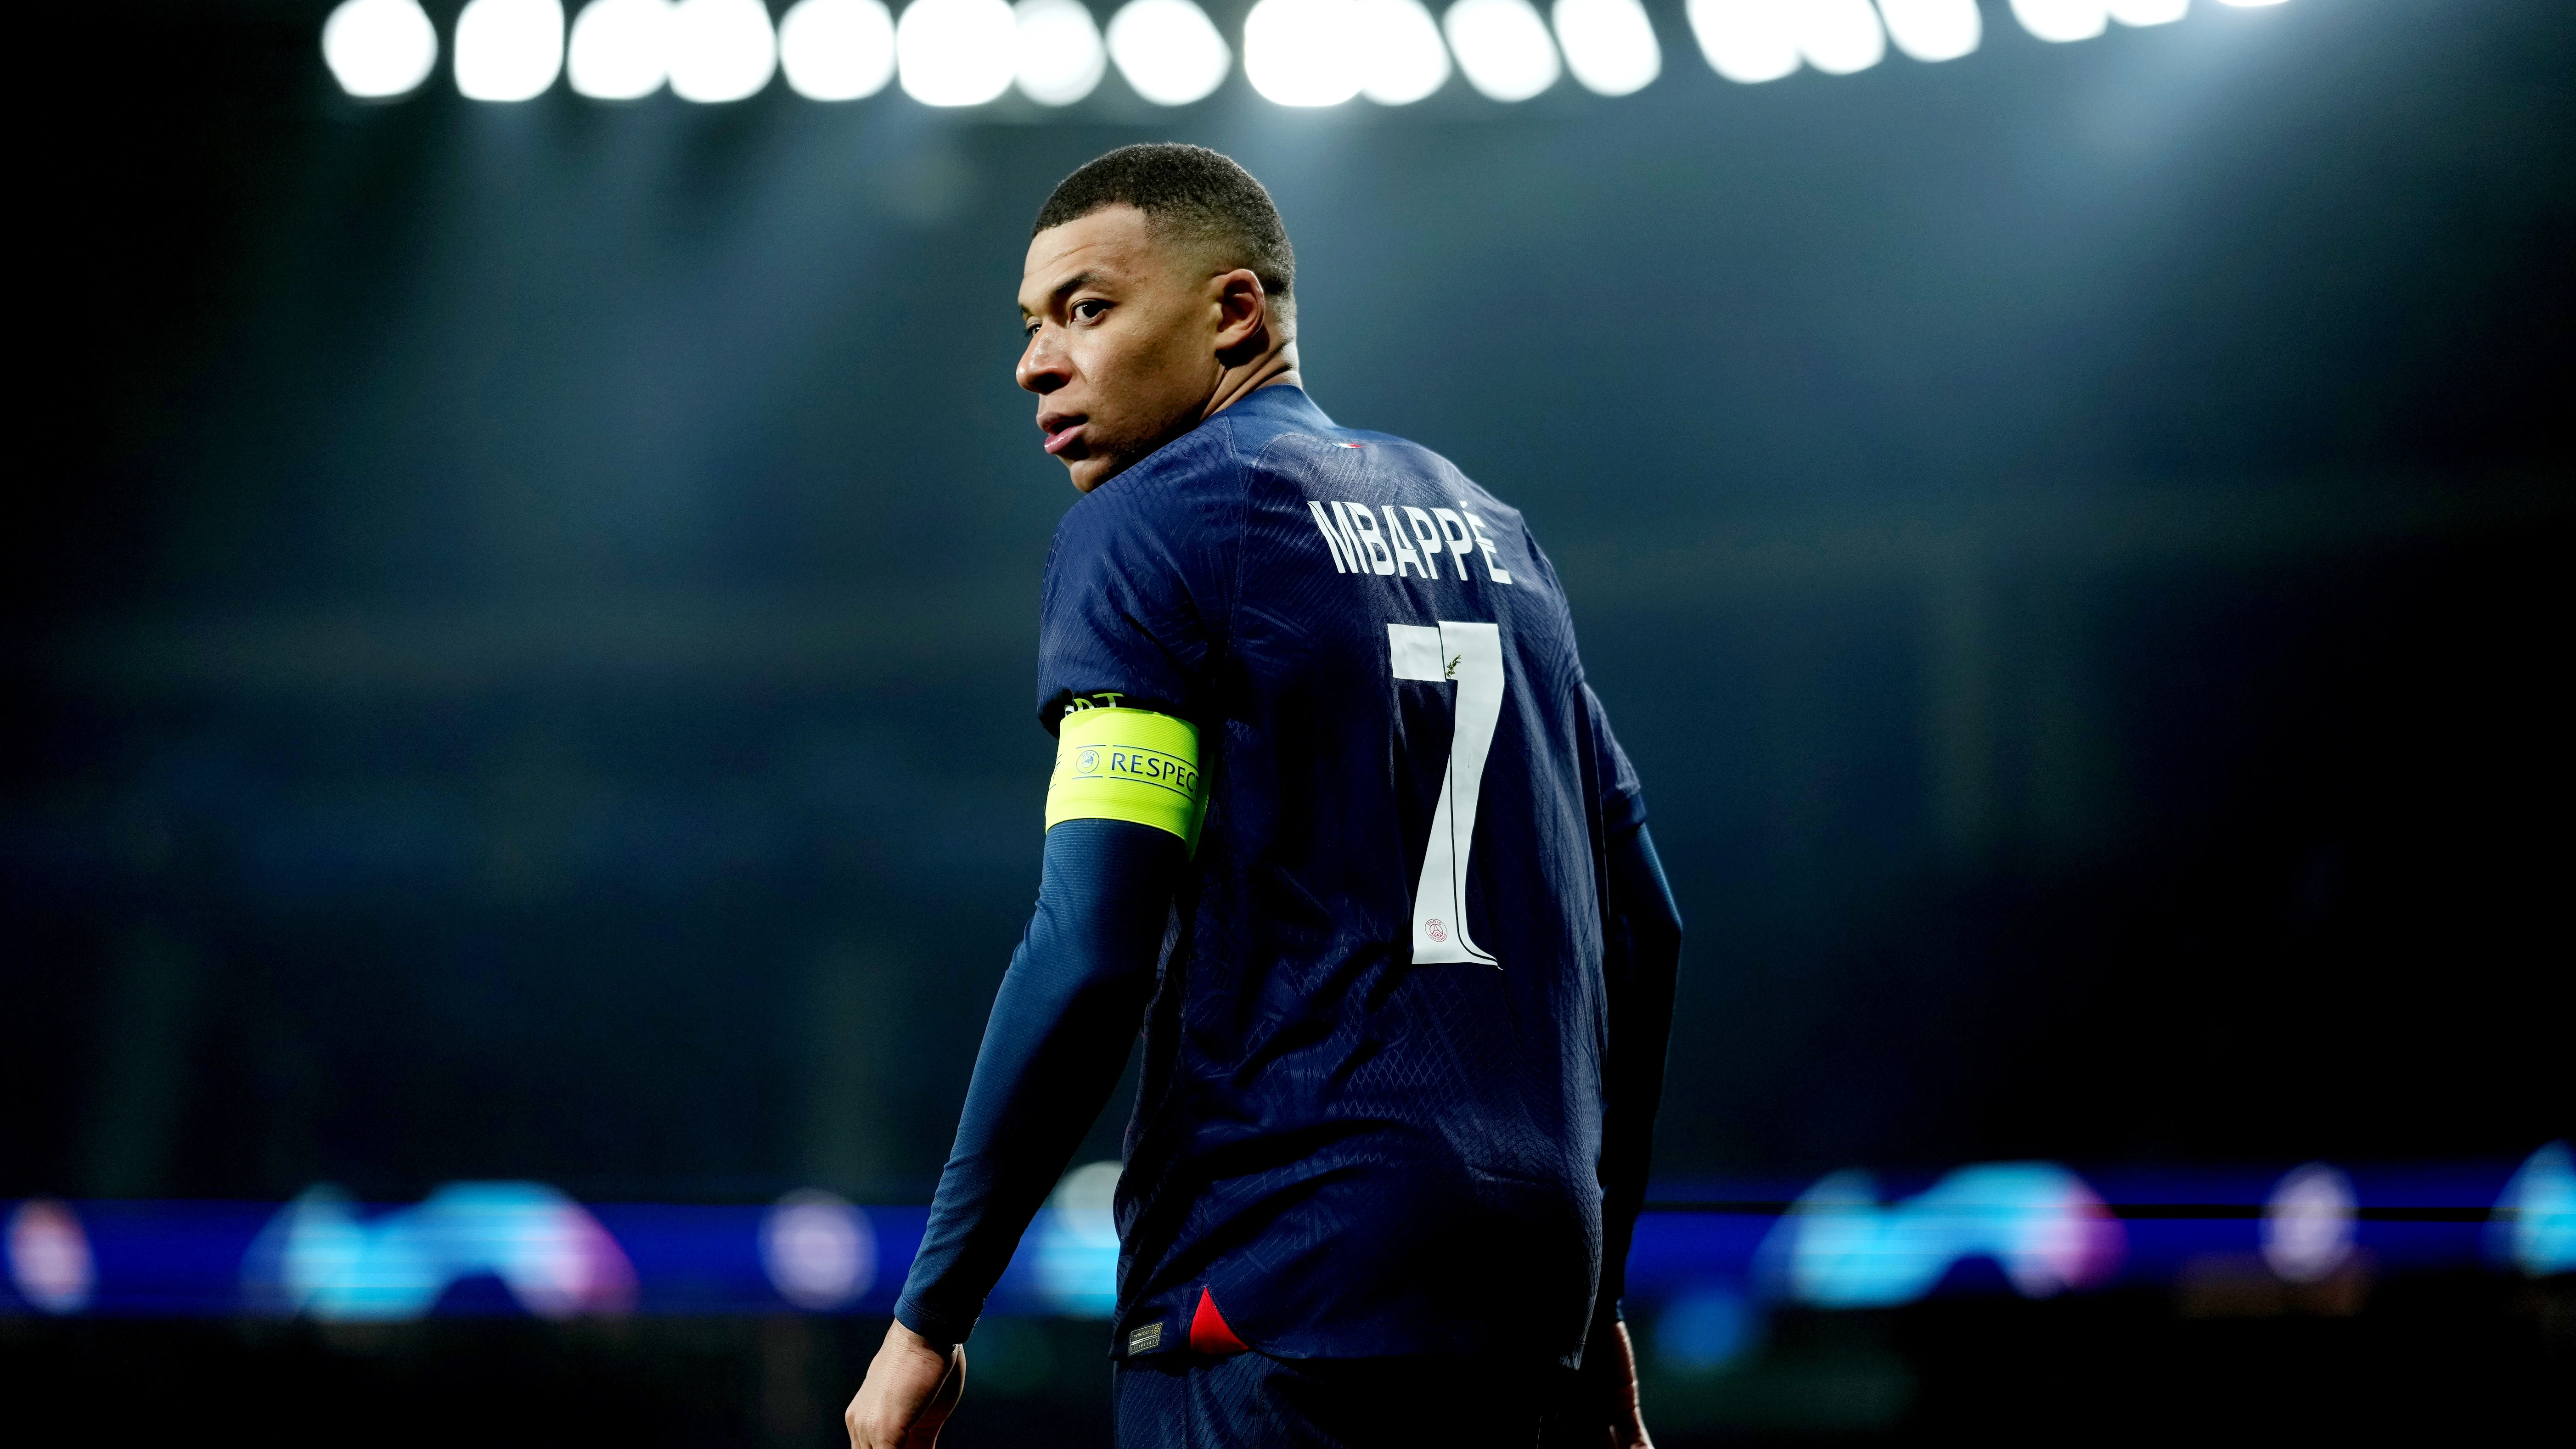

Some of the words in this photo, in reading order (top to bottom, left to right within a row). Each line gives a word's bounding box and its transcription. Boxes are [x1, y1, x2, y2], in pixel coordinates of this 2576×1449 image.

[1307, 500, 1512, 584] MBAPPÉ
[1387, 621, 1504, 972] 7
[1429, 933, 1446, 941] SAINT-GERMAIN
[1131, 1329, 1152, 1339] ENGINEERED
